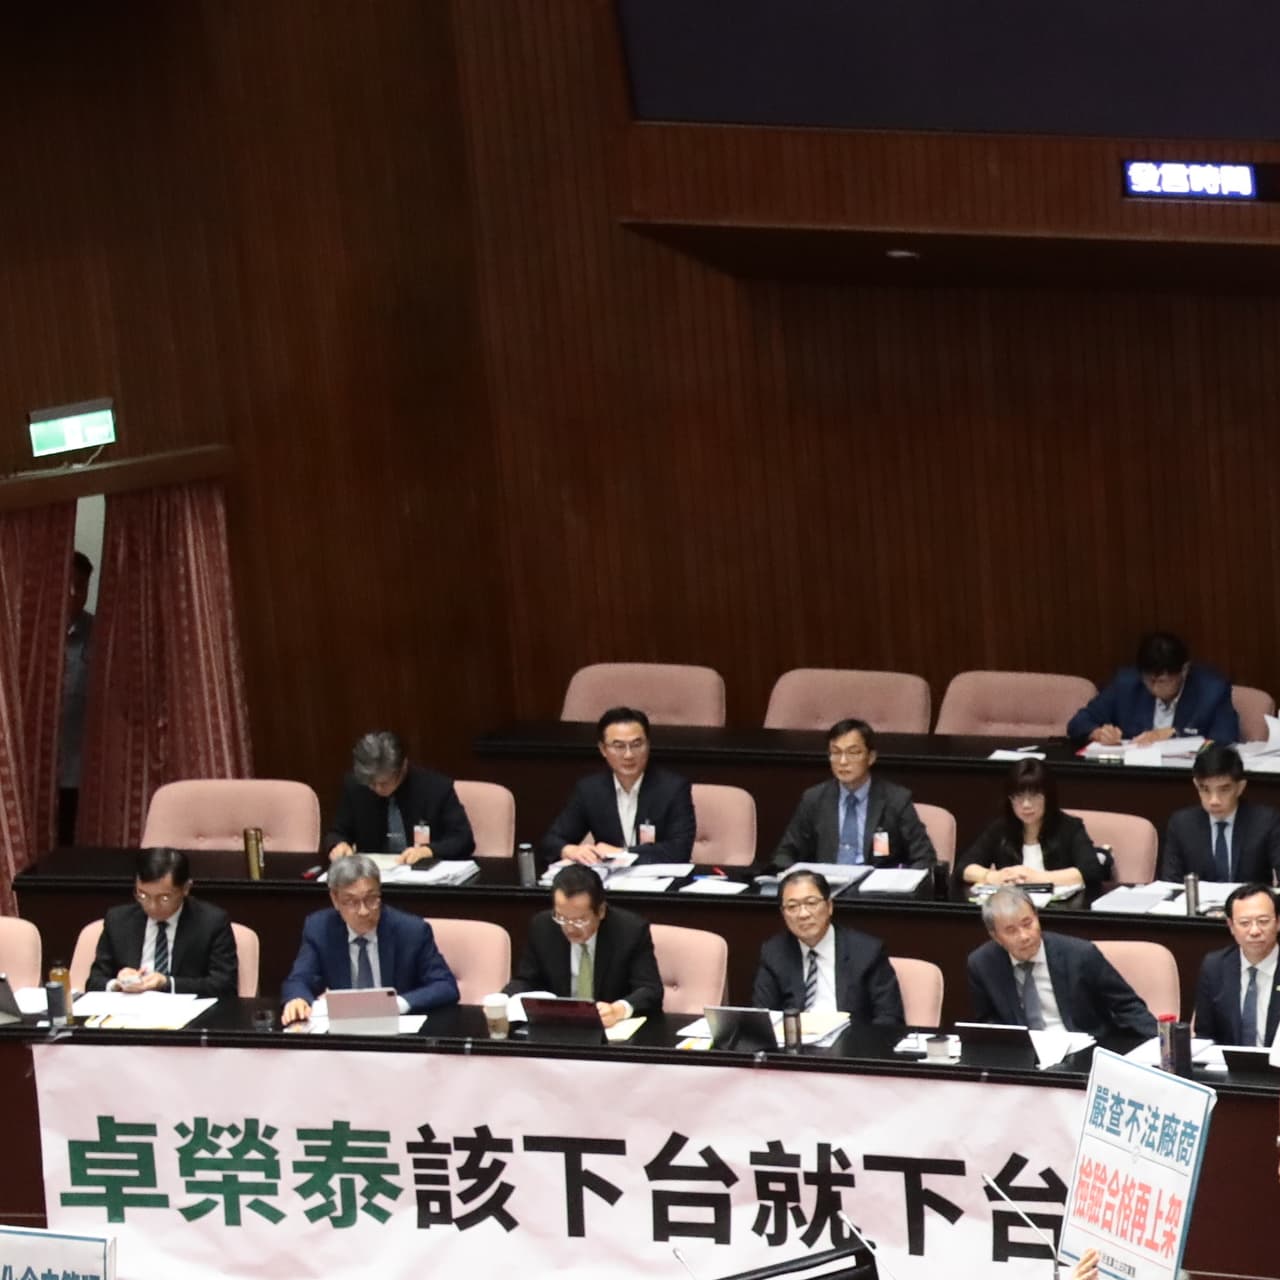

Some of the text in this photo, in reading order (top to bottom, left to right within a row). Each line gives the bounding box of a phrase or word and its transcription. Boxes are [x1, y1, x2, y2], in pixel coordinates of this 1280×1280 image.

[1087, 1085, 1200, 1166] 嚴查不法廠商
[60, 1115, 1069, 1267] 卓榮泰該下台就下台
[1072, 1153, 1183, 1260] 檢驗合格再上架
